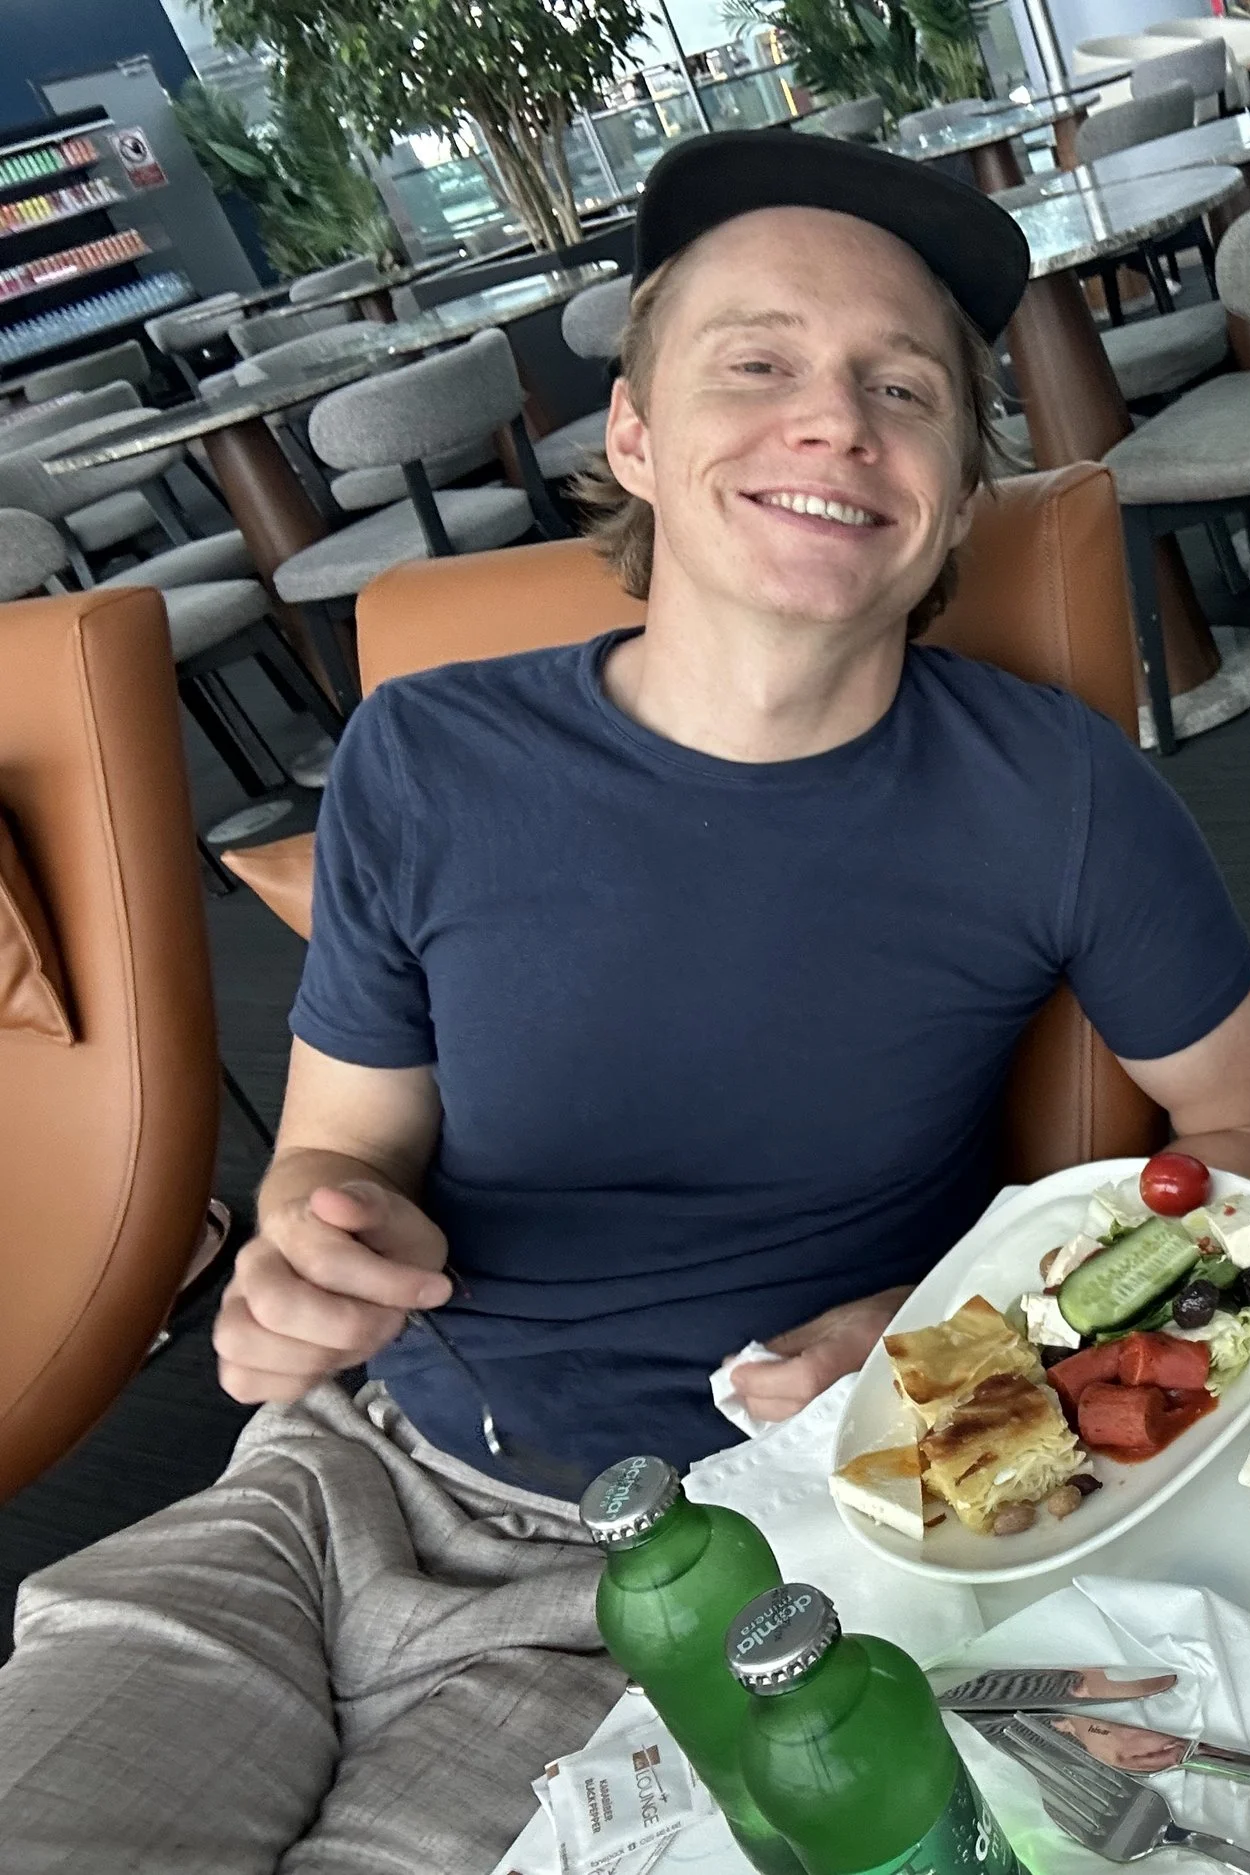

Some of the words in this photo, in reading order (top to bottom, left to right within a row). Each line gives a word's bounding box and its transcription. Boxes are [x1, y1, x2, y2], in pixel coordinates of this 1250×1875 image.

[606, 1458, 648, 1514] damla
[736, 1594, 812, 1655] damla
[588, 1802, 601, 1834] PEPPER
[634, 1769, 660, 1828] LOUNGE
